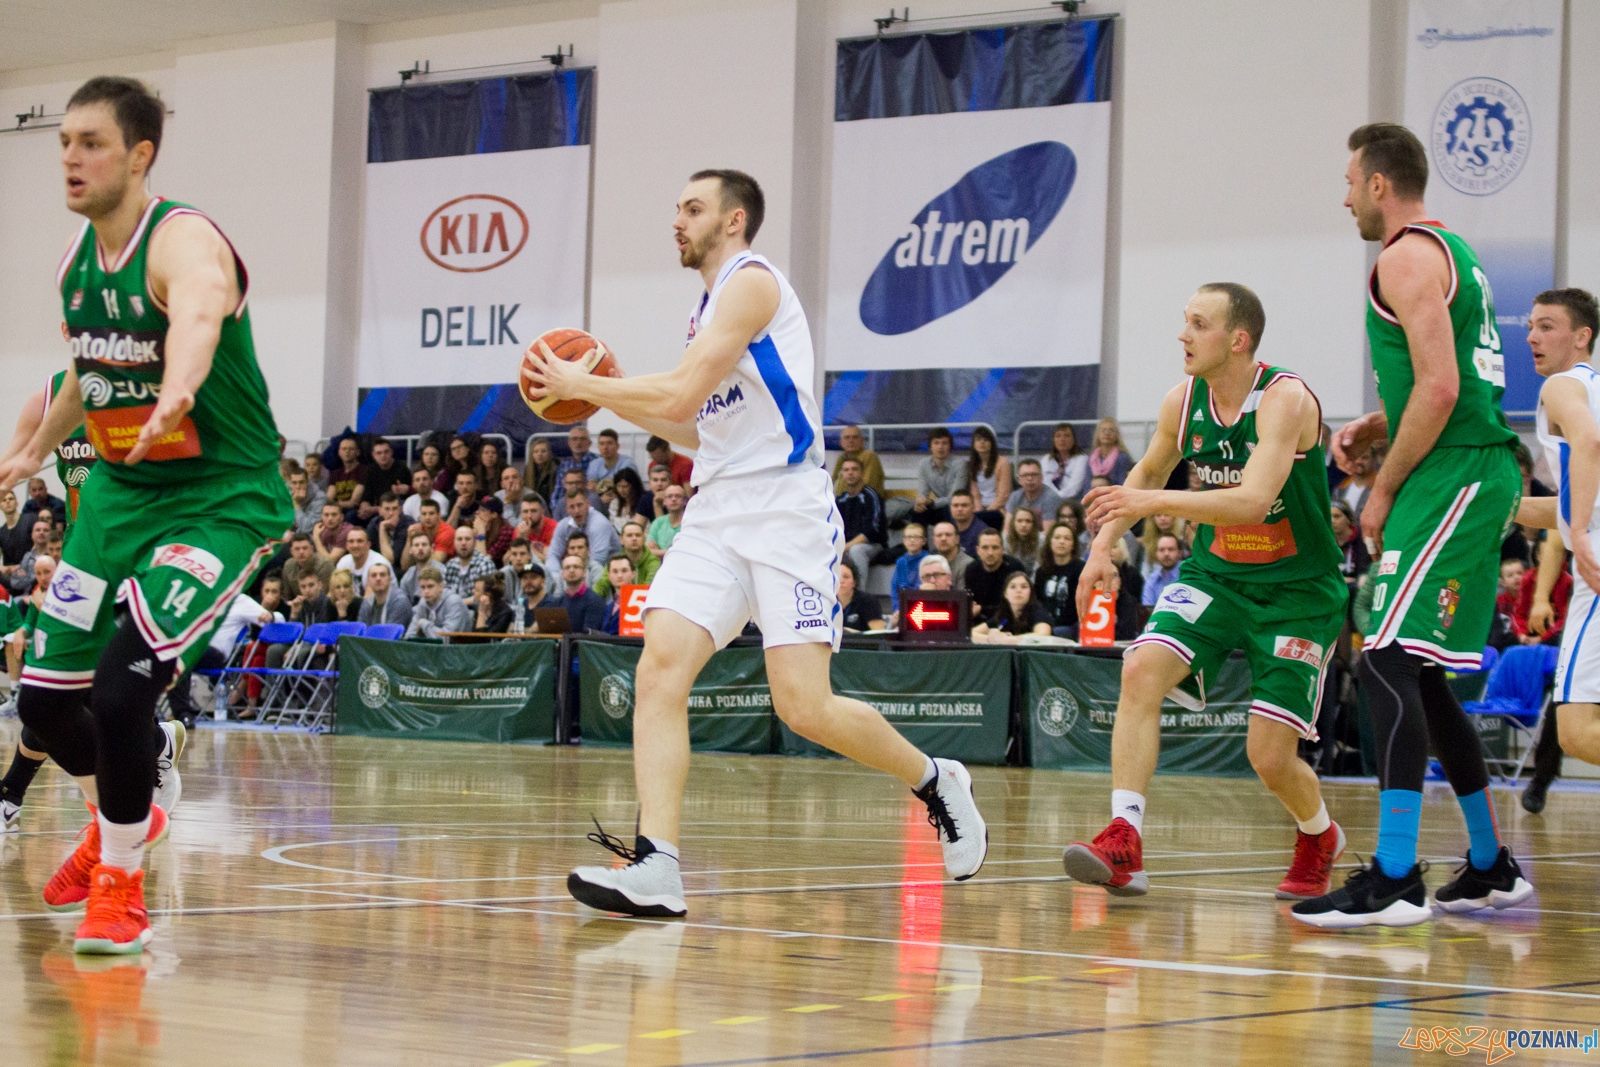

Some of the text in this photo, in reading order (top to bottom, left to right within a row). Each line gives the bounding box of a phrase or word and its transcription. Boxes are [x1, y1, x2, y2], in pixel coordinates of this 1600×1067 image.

[440, 212, 510, 256] KIA
[894, 210, 1030, 268] atrem
[101, 288, 121, 320] 14
[421, 304, 521, 348] DELIK
[69, 331, 160, 363] otolotek
[161, 578, 198, 618] 14
[624, 589, 649, 622] 5
[794, 581, 823, 617] 8
[1086, 594, 1112, 631] 5
[400, 684, 527, 700] POLITECHNIKA POZNAŃSKA
[716, 693, 772, 709] POZNAŃSK
[919, 701, 983, 717] POZNAŃSKA
